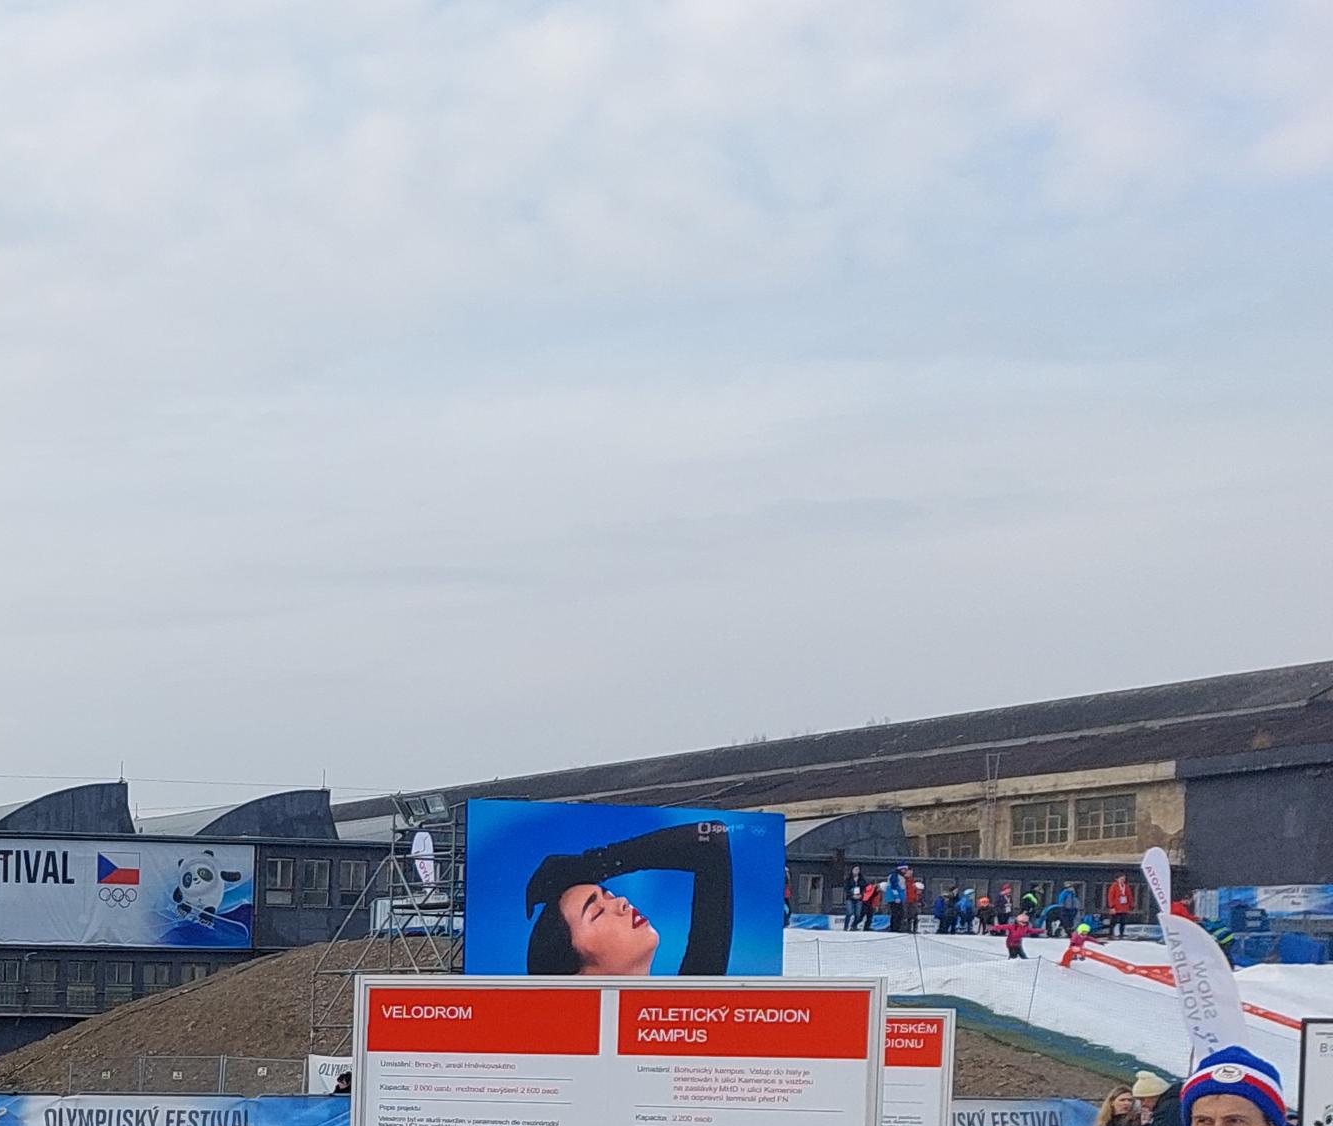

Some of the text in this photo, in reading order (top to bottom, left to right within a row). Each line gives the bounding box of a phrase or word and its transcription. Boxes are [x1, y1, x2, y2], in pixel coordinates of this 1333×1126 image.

[382, 1005, 473, 1020] VELODROM
[637, 1006, 810, 1024] ATLETICKÝ STADION
[637, 1028, 708, 1043] KAMPUS
[885, 1022, 938, 1034] STSKÉM
[884, 1037, 925, 1049] DIONU
